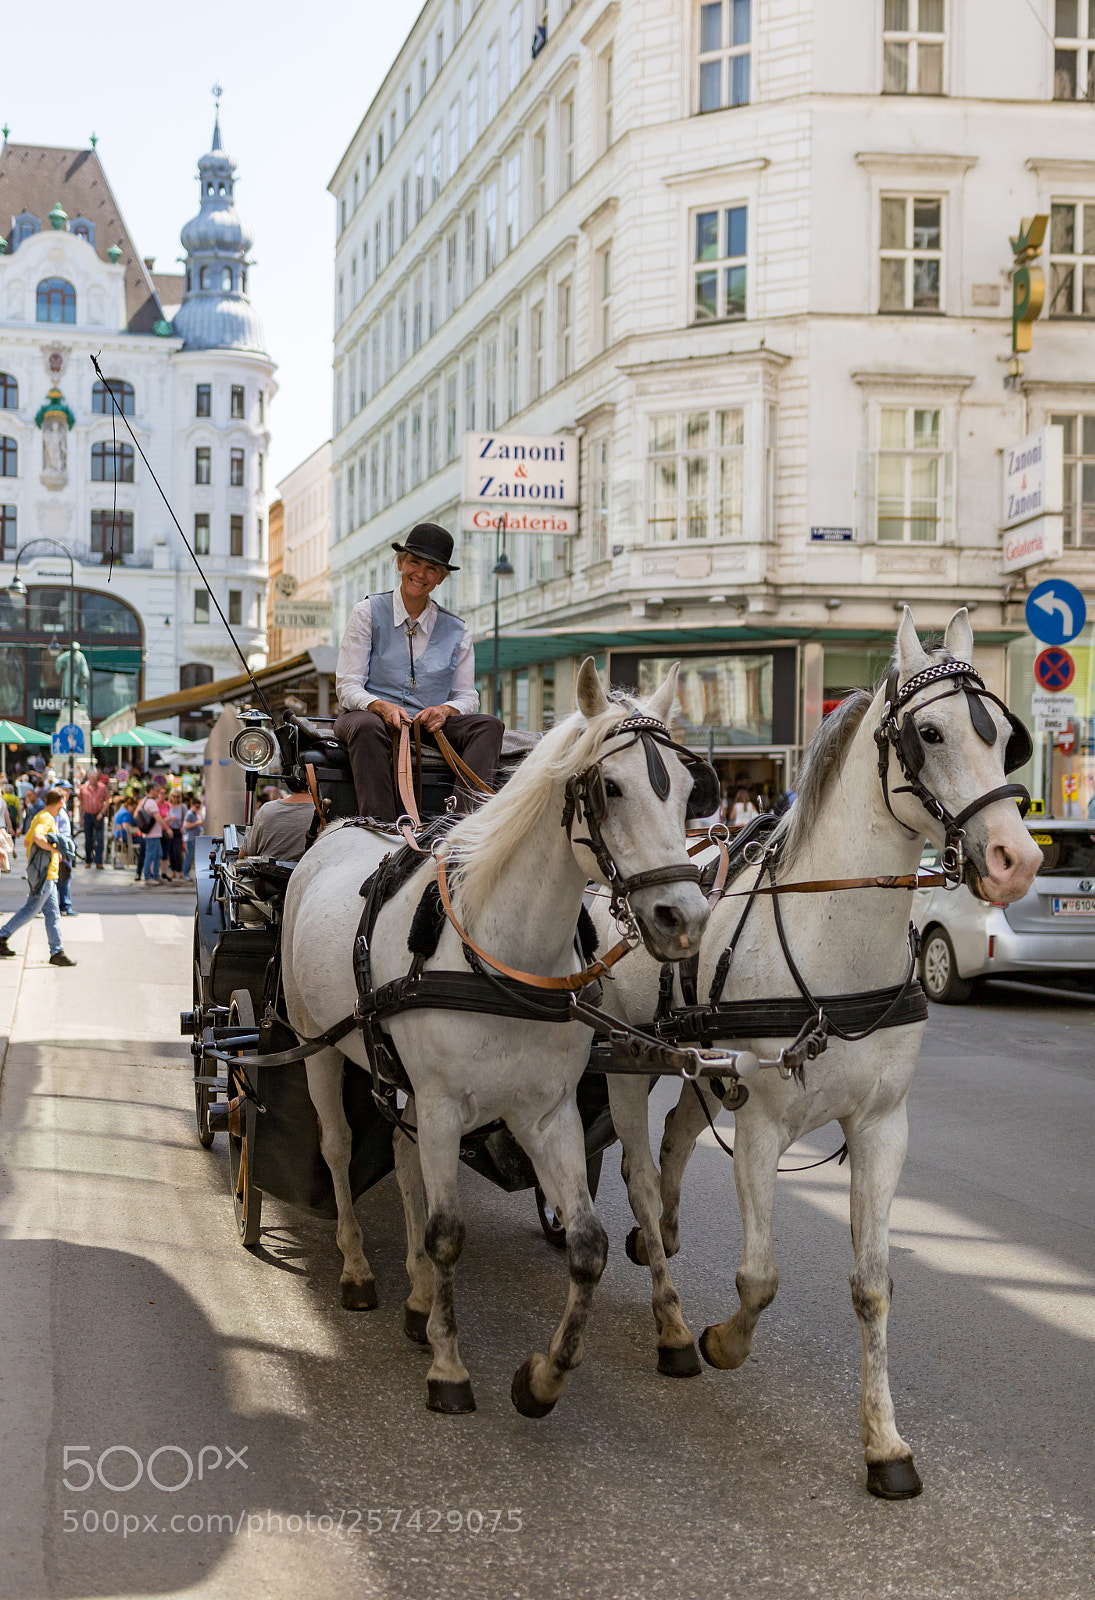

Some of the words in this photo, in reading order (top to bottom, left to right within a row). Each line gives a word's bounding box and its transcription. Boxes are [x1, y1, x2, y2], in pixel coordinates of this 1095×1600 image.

[479, 438, 565, 461] Zanoni
[1008, 437, 1042, 477] Zanoni
[514, 463, 528, 478] &
[479, 476, 565, 499] Zanoni
[1008, 482, 1042, 520] Zanoni
[473, 511, 568, 531] Gelateria
[1005, 533, 1043, 562] Gelateria
[1061, 900, 1068, 911] W
